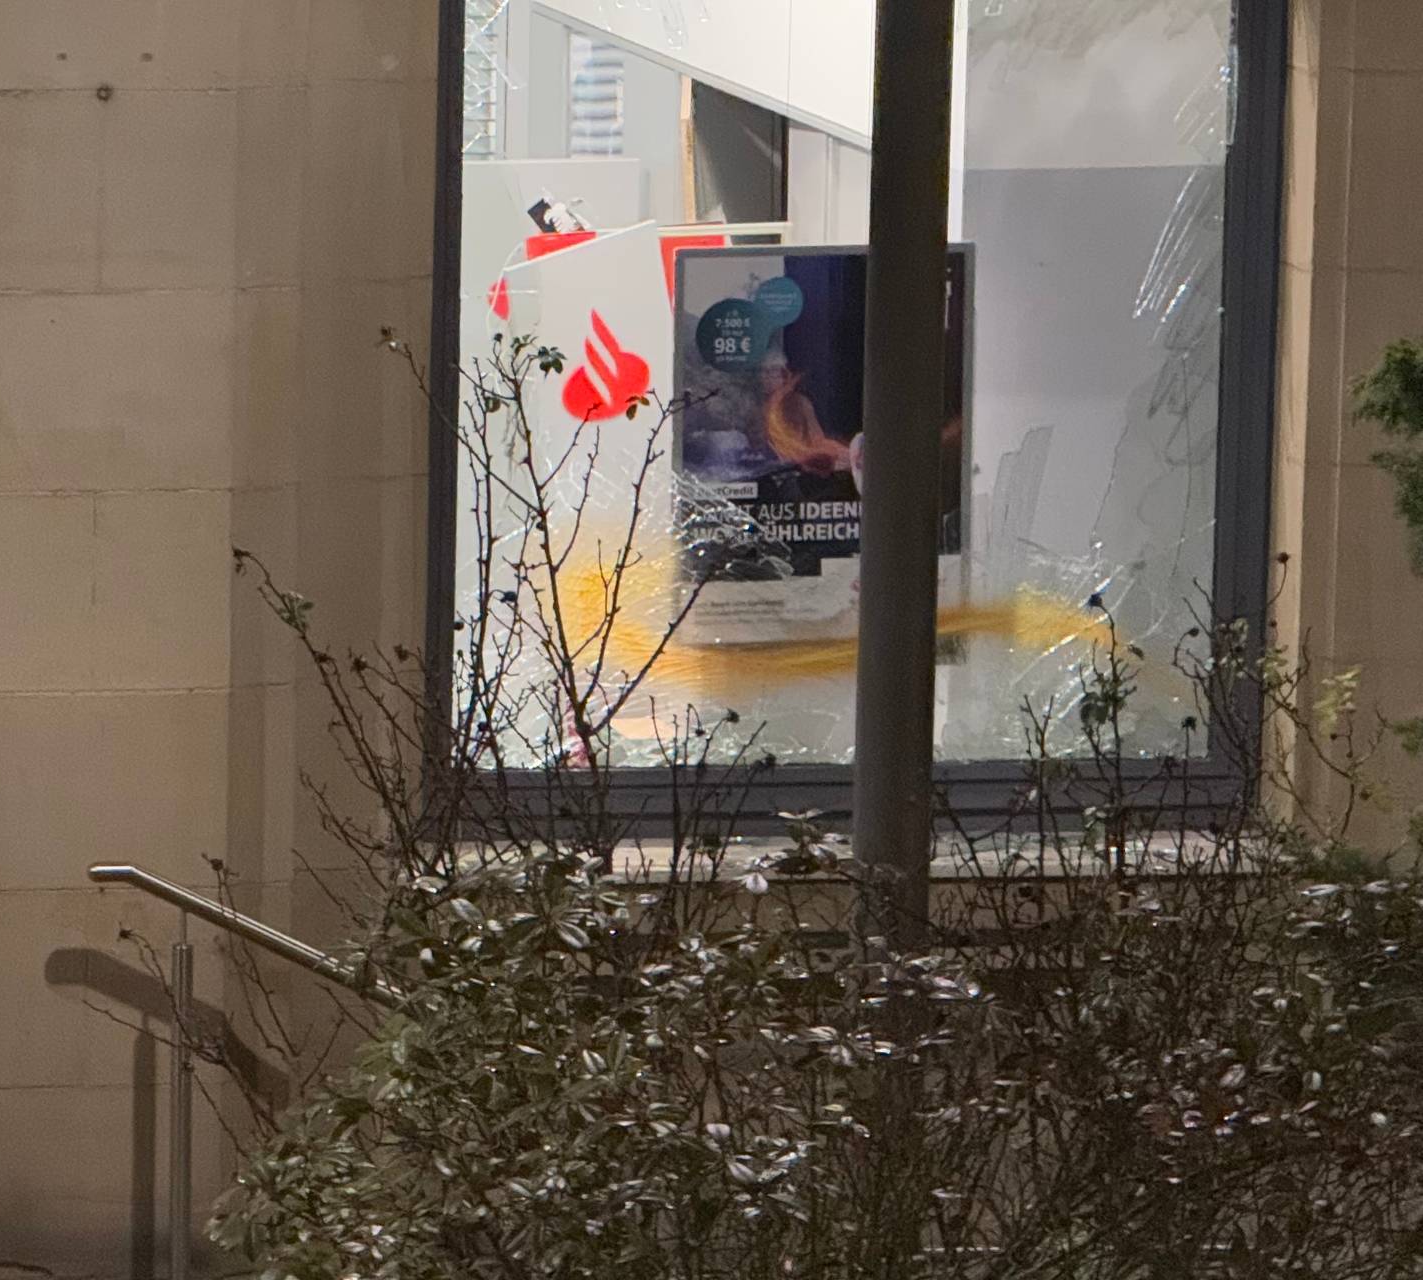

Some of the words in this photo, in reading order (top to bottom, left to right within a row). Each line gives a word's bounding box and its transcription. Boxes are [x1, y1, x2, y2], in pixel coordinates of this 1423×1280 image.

[714, 337, 736, 354] 98
[740, 337, 751, 353] €
[758, 503, 795, 521] AUS
[799, 501, 863, 520] IDEEN
